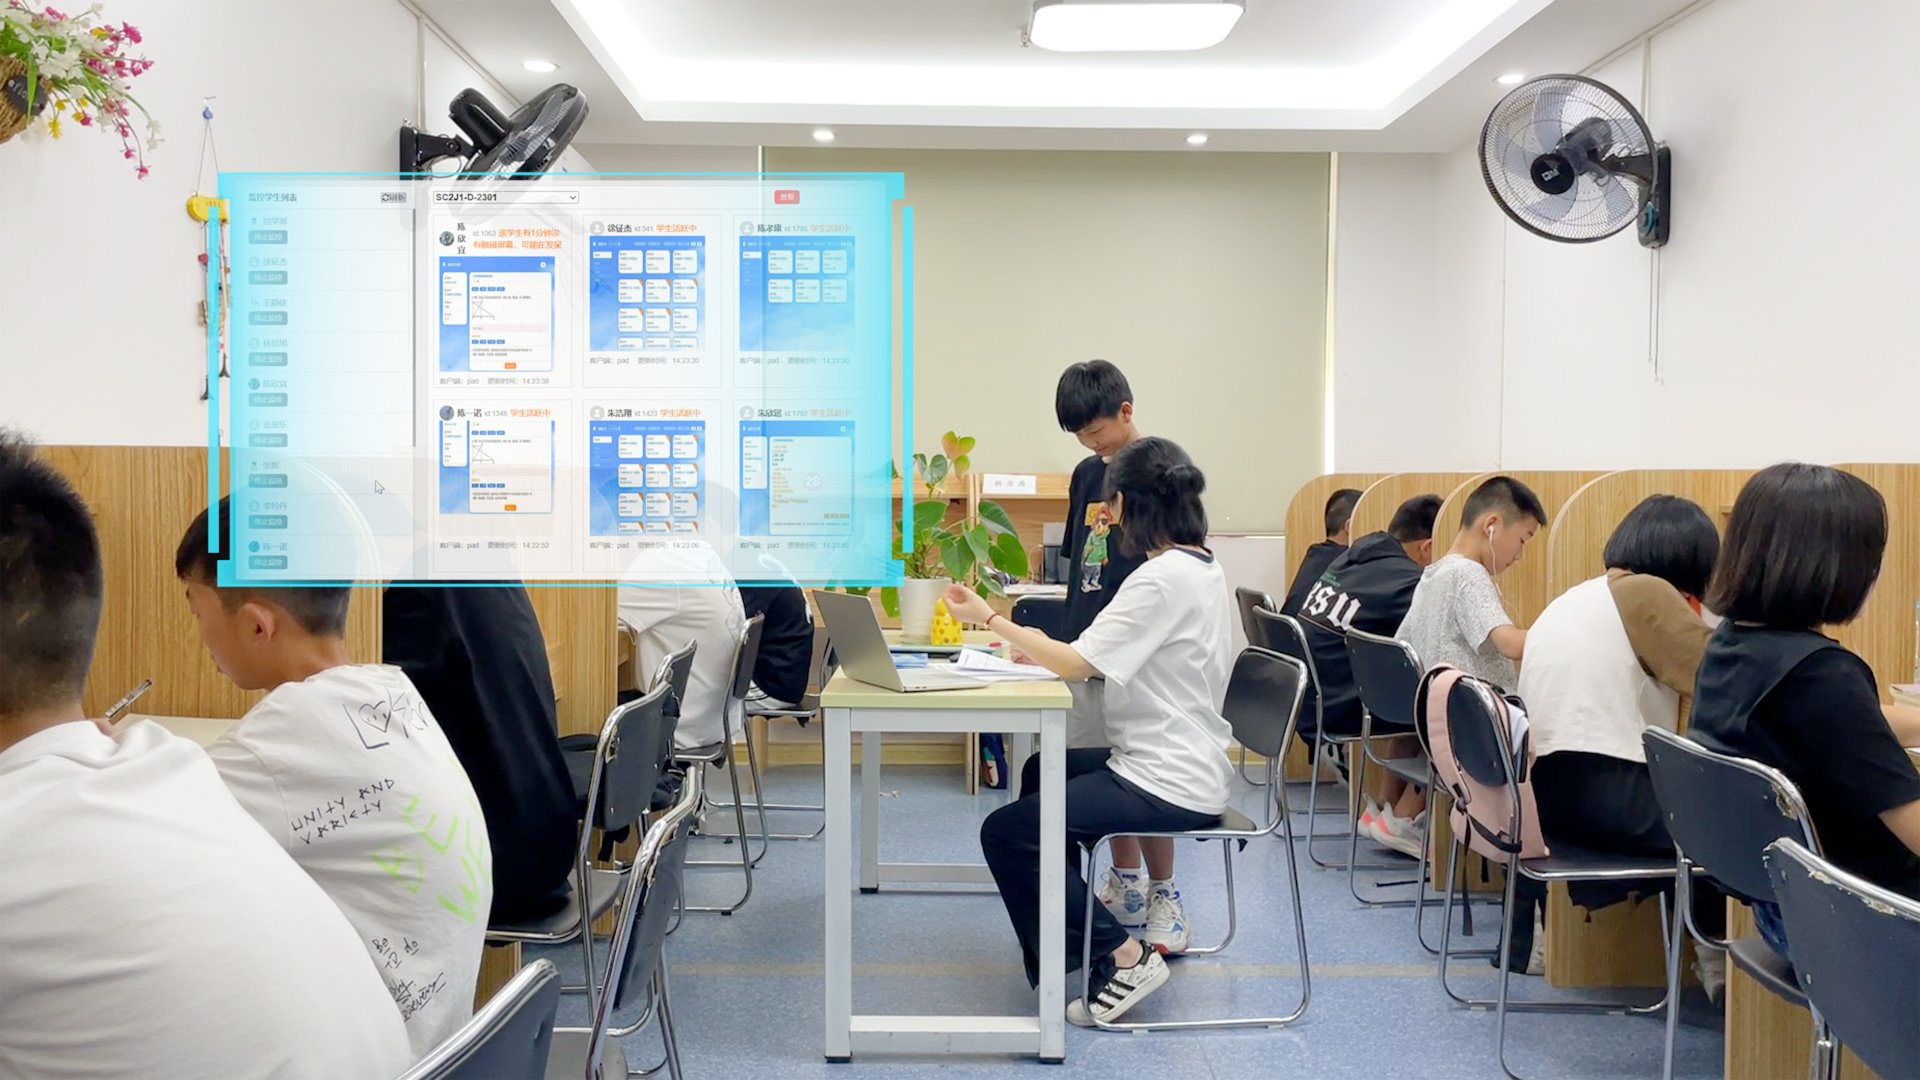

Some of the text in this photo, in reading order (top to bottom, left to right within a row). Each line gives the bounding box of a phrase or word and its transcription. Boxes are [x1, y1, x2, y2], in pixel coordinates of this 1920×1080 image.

[290, 778, 395, 832] UNITY AND
[299, 799, 382, 845] VARIETY
